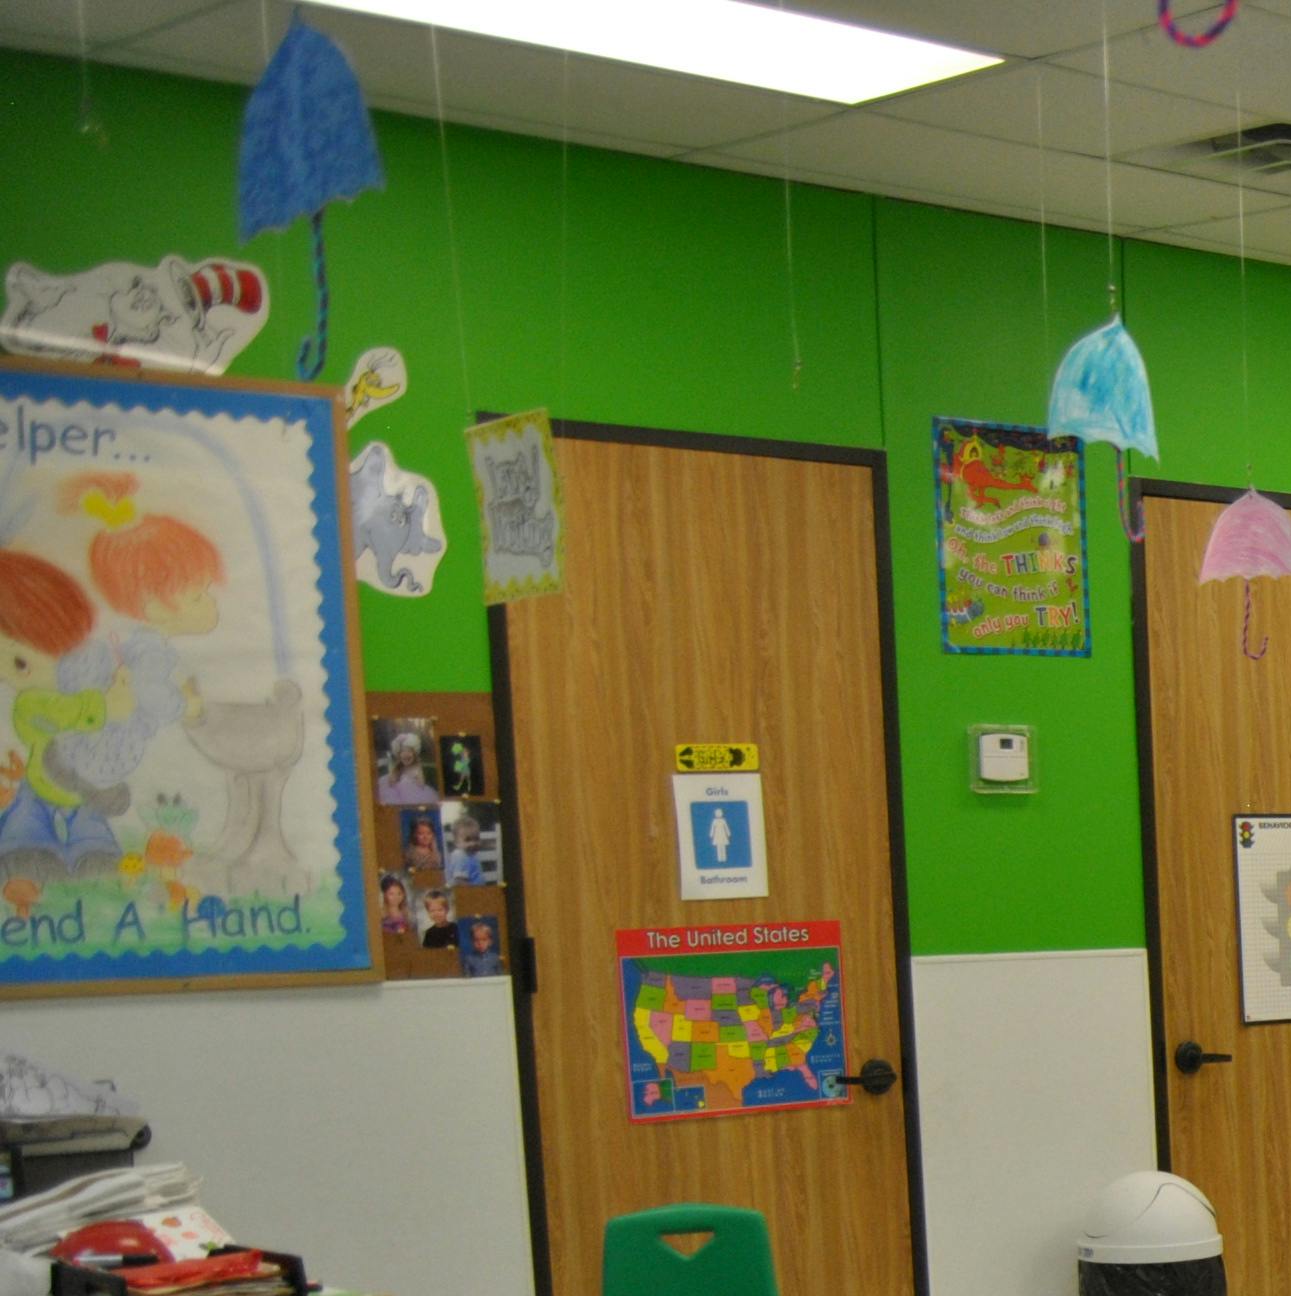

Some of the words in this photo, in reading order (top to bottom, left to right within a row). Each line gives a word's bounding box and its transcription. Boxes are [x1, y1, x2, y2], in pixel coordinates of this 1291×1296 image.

[0, 405, 151, 465] lper...
[1001, 551, 1078, 577] THINKS
[957, 567, 984, 589] you
[986, 582, 1009, 598] can
[1012, 585, 1046, 602] think
[972, 615, 1004, 638] only
[1004, 613, 1030, 632] you
[1035, 601, 1080, 628] TRY!
[705, 787, 729, 796] Girls
[700, 875, 748, 885] Bathroom
[112, 901, 147, 945] A
[646, 931, 681, 949] The
[686, 928, 748, 947] United
[753, 926, 810, 944] States
